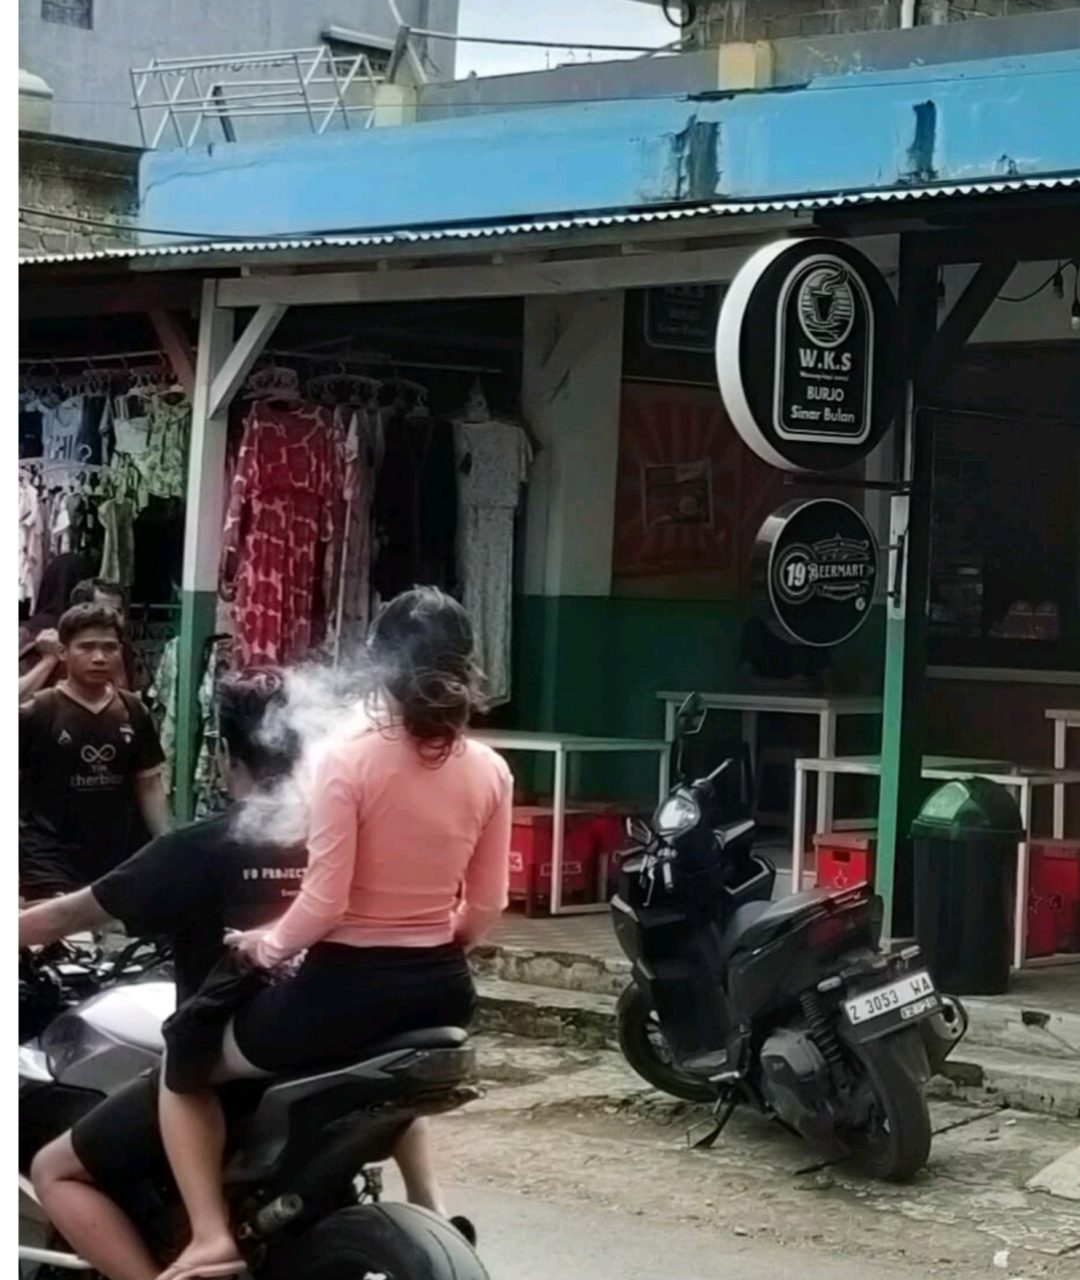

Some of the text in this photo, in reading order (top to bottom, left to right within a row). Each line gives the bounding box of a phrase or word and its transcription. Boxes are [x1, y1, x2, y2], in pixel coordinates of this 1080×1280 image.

[797, 347, 852, 372] W.K.S
[806, 385, 845, 402] BURJO
[789, 404, 855, 423] Sinar Bulan
[785, 561, 865, 588] 19 BEERMART
[849, 977, 931, 1022] Z 3053 WA
